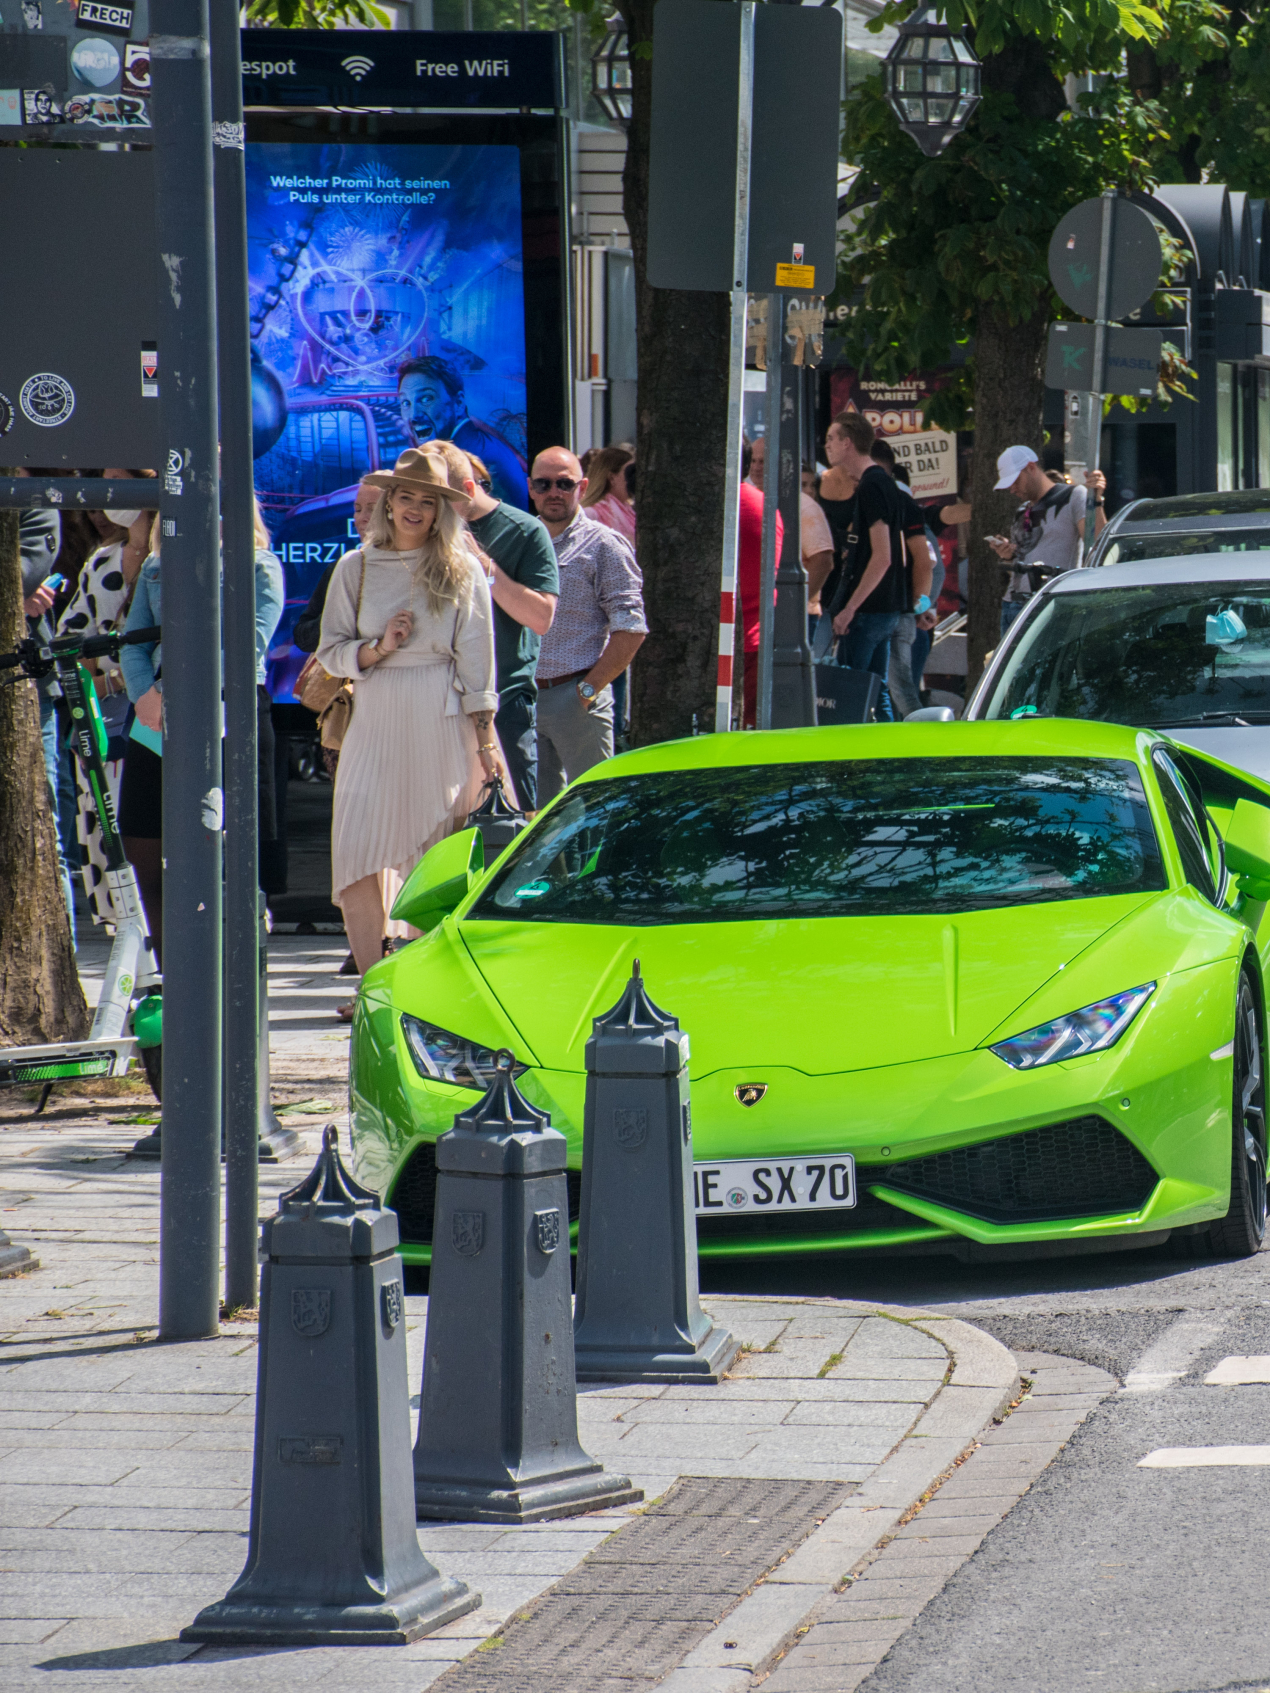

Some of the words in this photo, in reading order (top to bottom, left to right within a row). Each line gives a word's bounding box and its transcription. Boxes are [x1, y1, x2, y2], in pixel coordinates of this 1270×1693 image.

[80, 3, 131, 26] FRECH
[415, 60, 459, 77] Free
[464, 60, 510, 77] WiFi
[270, 175, 329, 189] Welcher
[331, 175, 373, 189] Promi
[376, 175, 401, 189] hat
[404, 176, 450, 189] seinen
[289, 191, 320, 204] Puls
[322, 193, 361, 204] unter
[364, 191, 436, 205] Kontrolle?
[868, 390, 918, 401] VARIETÉ
[892, 445, 911, 459] ND
[914, 439, 949, 456] BALD
[917, 457, 940, 473] DA!
[78, 729, 92, 757] Lime
[102, 790, 120, 834] Lime
[752, 1166, 797, 1205] SX
[806, 1163, 850, 1202] 70
